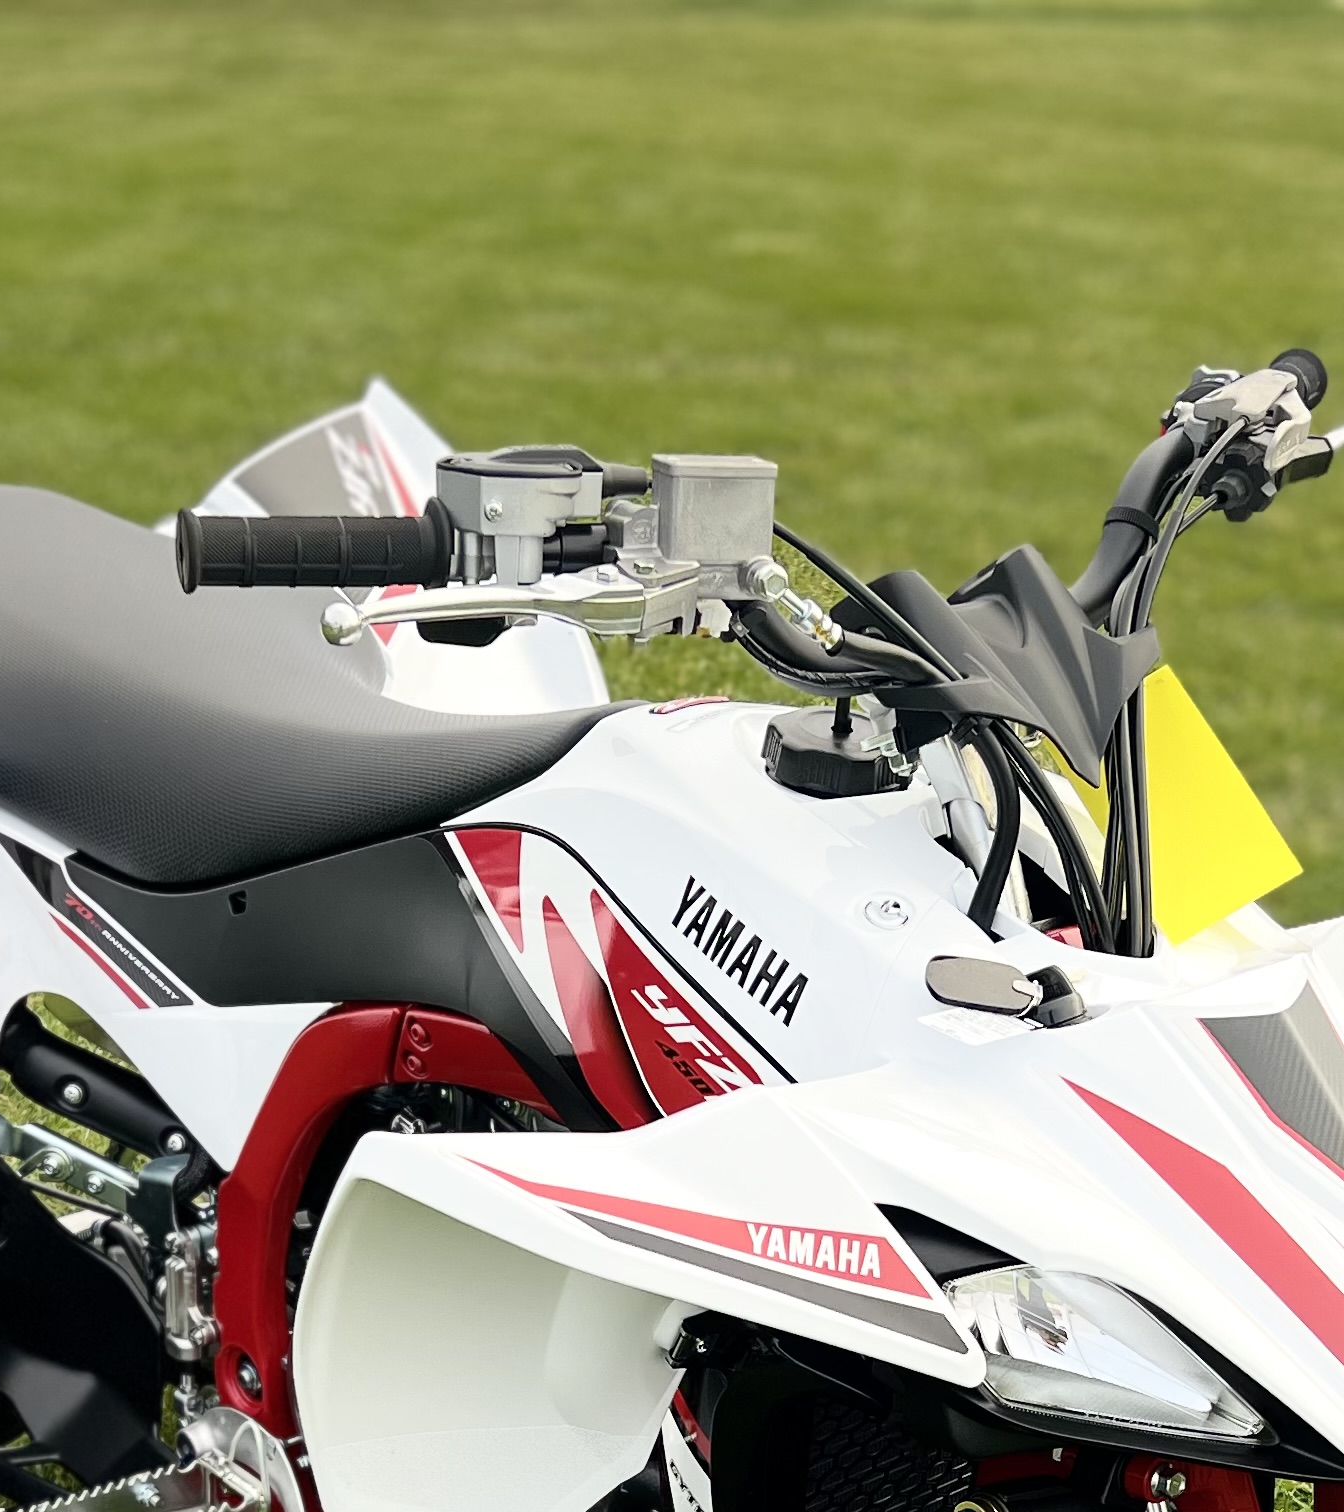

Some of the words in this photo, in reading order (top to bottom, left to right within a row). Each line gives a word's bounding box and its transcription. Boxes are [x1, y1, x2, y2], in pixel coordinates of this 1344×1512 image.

[101, 929, 180, 1000] ANNIVERSARY
[671, 874, 809, 1028] YAMAHA
[630, 984, 762, 1094] YFZ
[746, 1222, 881, 1279] YAMAHA
